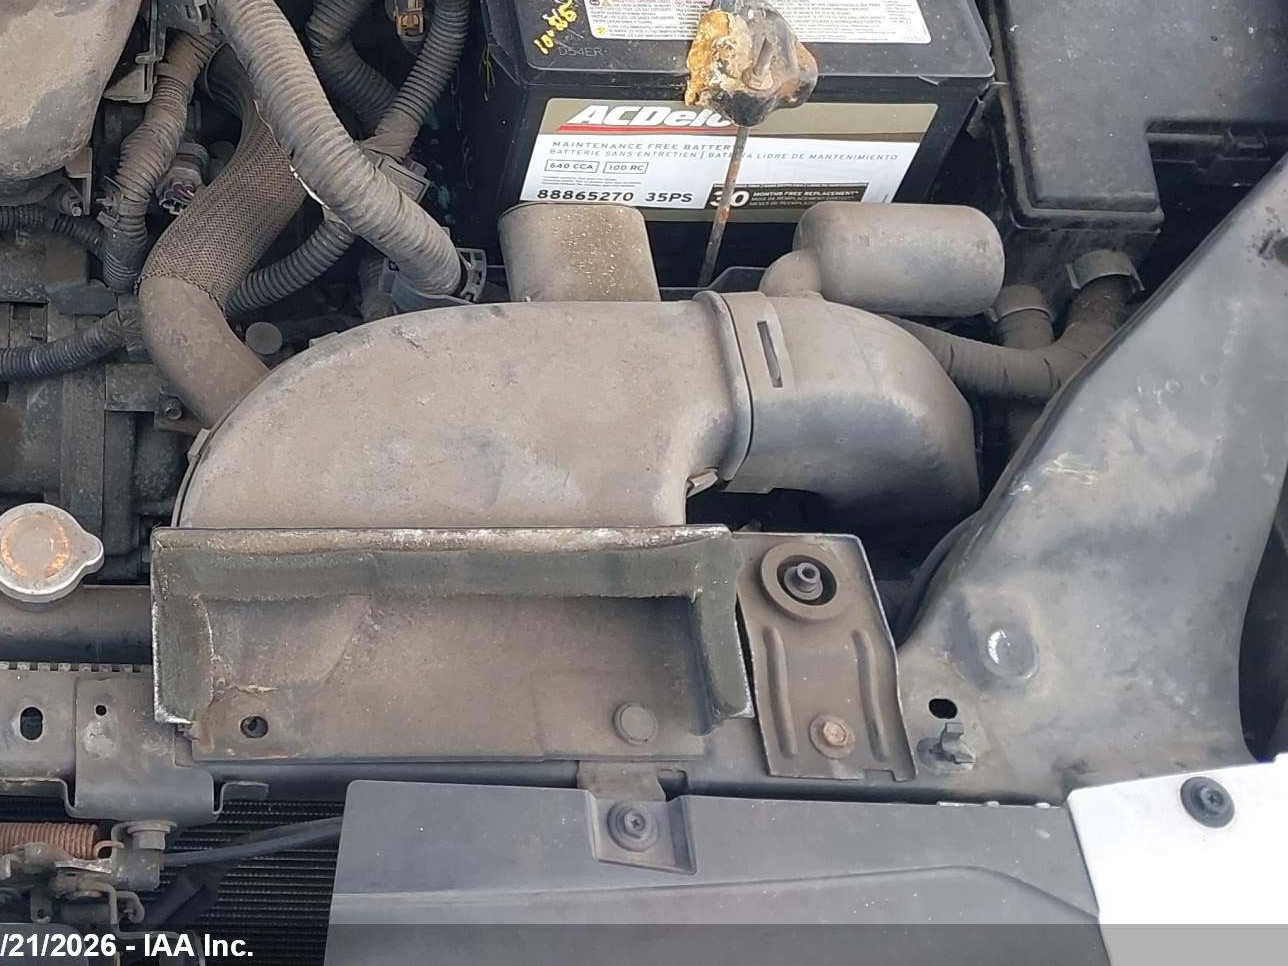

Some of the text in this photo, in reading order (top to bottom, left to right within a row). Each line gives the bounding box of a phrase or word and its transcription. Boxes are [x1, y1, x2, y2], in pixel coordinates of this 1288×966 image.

[567, 105, 732, 127] ACDelc
[552, 141, 643, 150] MAINTENANCE
[683, 144, 735, 152] BATTER
[536, 189, 694, 203] 88865270 35PS
